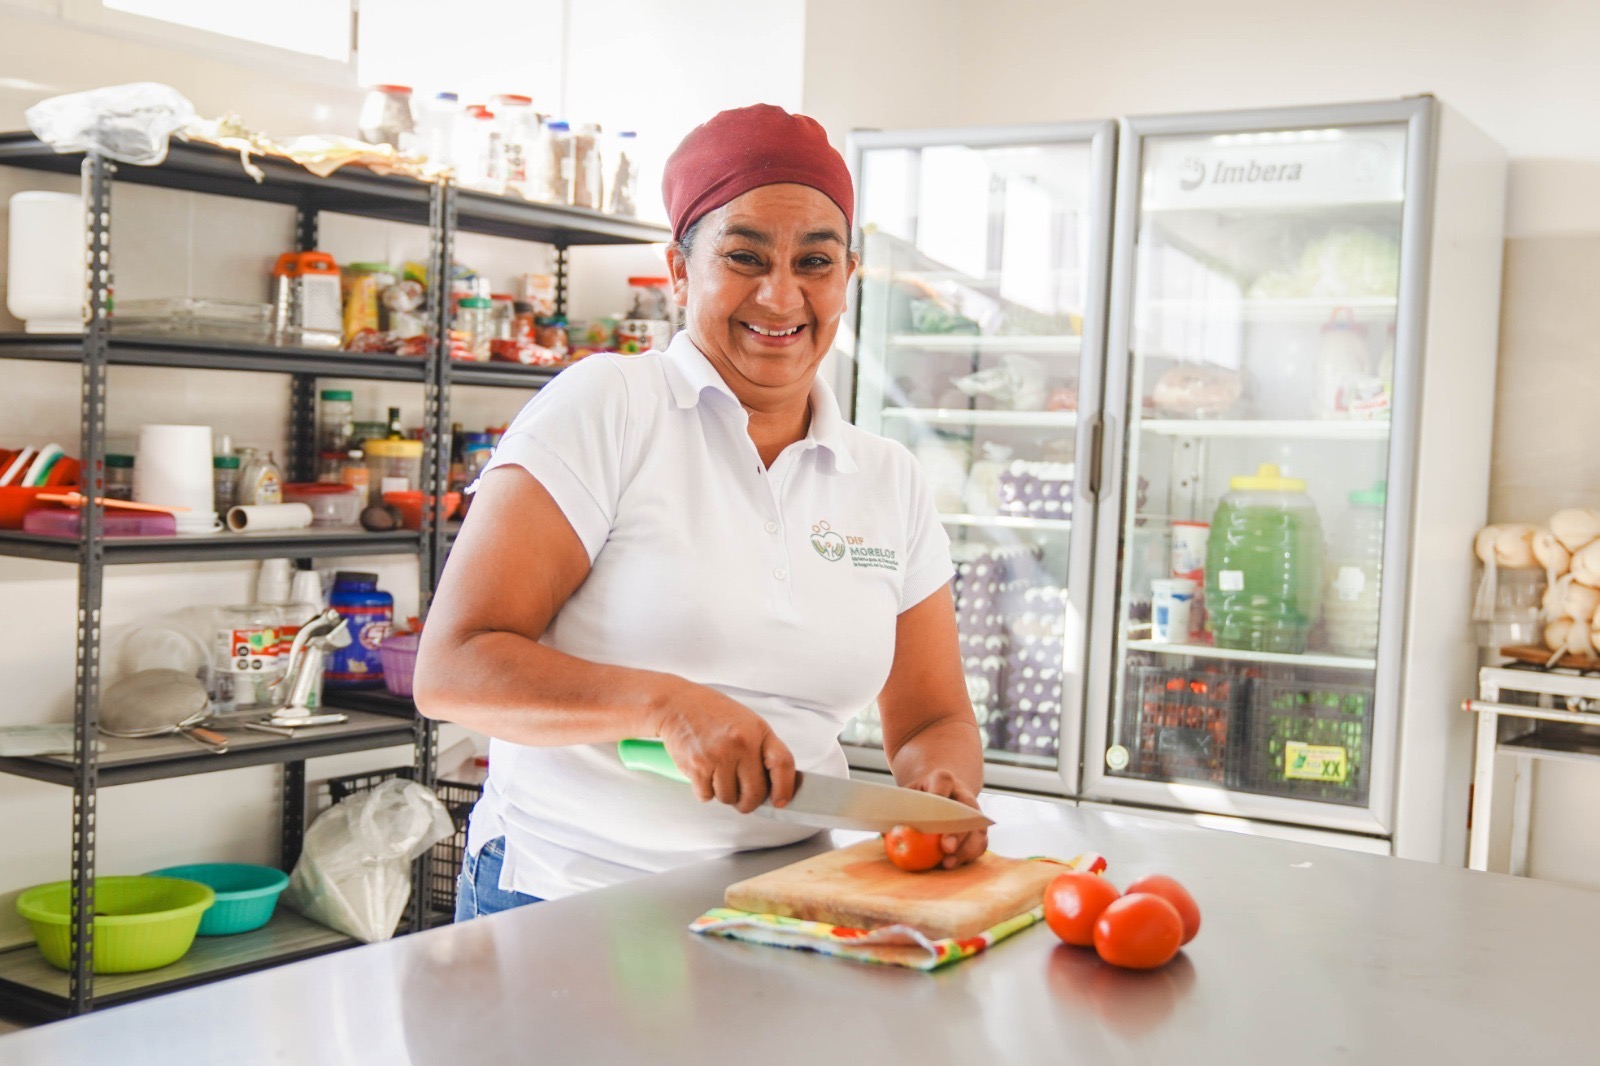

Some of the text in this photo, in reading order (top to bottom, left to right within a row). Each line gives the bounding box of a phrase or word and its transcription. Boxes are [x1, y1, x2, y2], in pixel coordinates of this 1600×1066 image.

[1212, 159, 1304, 184] Imbera
[846, 535, 864, 546] DIF
[849, 547, 896, 559] MORELOS
